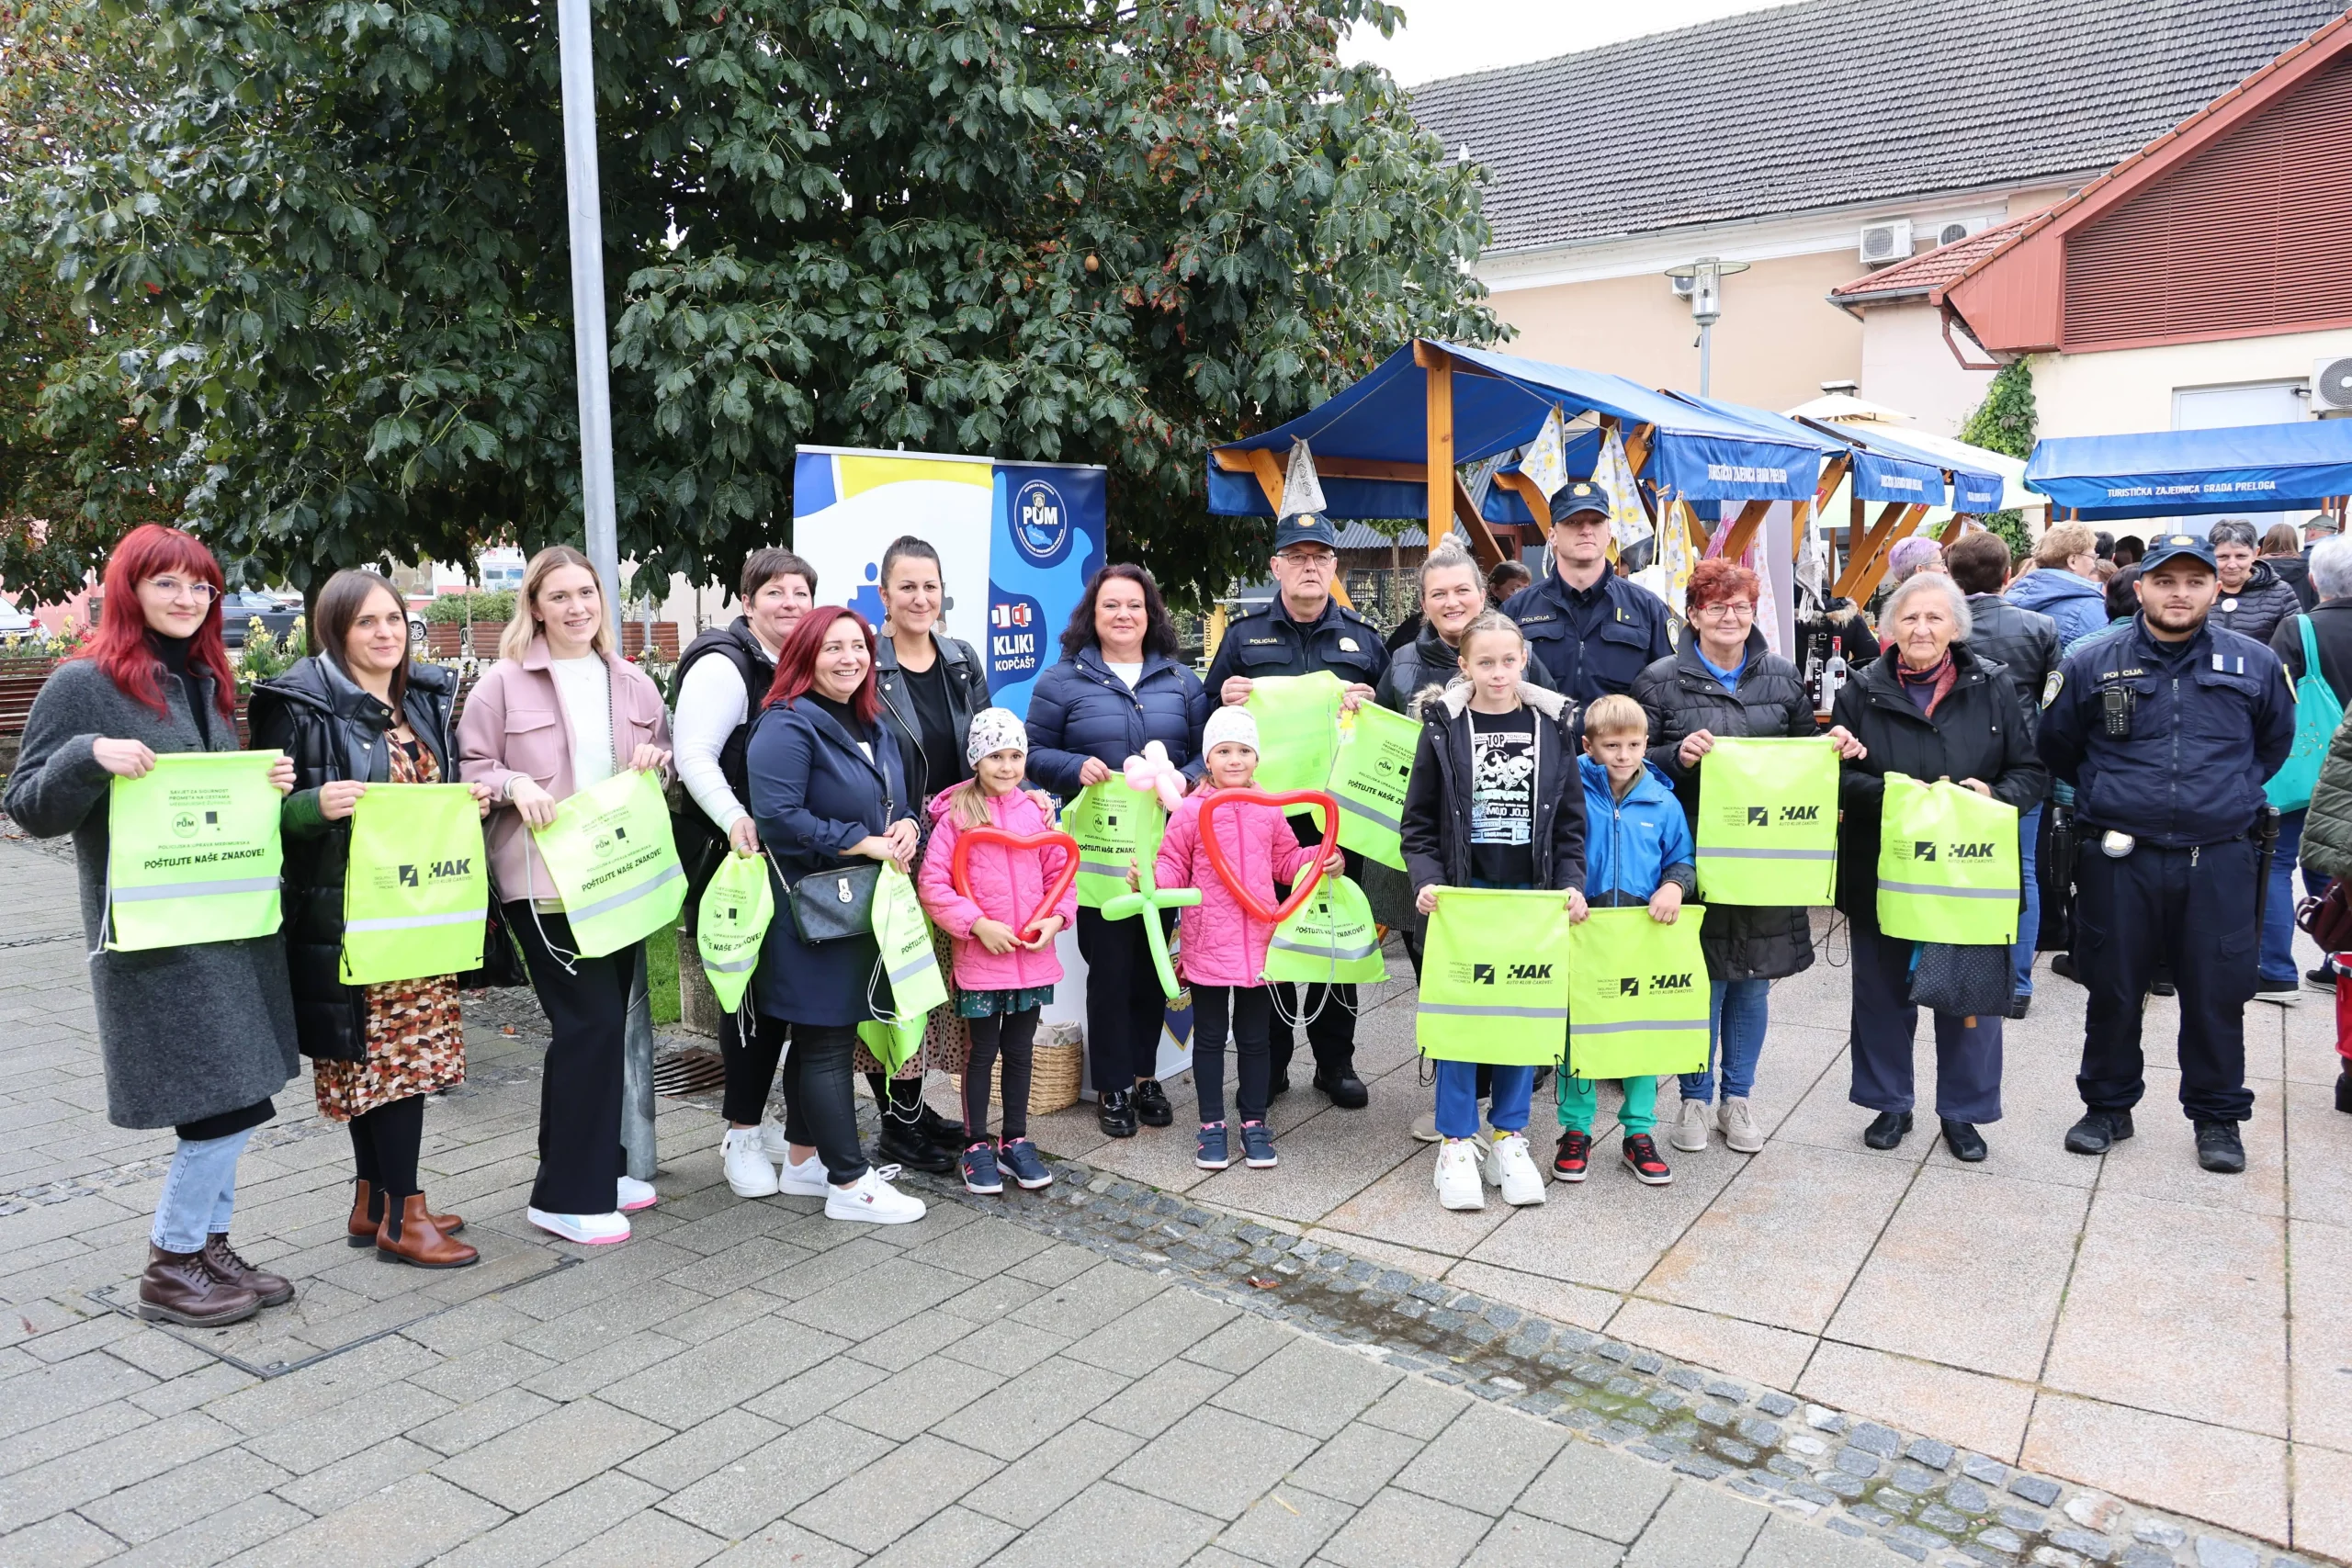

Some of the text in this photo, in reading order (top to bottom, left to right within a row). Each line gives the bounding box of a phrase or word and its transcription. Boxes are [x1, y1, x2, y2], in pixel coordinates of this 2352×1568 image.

[2107, 480, 2276, 498] TURISTIČKA ZAJEDNICA GRADA PRELOGA
[1023, 506, 1057, 525] PUM
[1521, 615, 1550, 623] POLICIJA
[993, 633, 1035, 656] KLIK!
[994, 655, 1035, 671] KOPČAŠ?
[2103, 668, 2143, 680] POLCIJA
[1488, 735, 1505, 746] TOP
[1378, 761, 1392, 771] PUM
[1348, 779, 1406, 807] POŠTUJTE NAŠE ZN
[1487, 807, 1530, 818] MOJO JOJO
[1780, 806, 1820, 820] HAK
[595, 840, 610, 850] PUM
[1948, 842, 1996, 858] HAK
[144, 848, 265, 869] POŠTUJTE NAŠE ZNAKOVE!
[428, 858, 470, 878] HAK
[581, 847, 662, 892] POŠTUJTE NAŠE ZNAKOVE!
[713, 943, 732, 952] NAŠE
[1507, 964, 1554, 978] HAK
[1649, 972, 1693, 989] HAK
